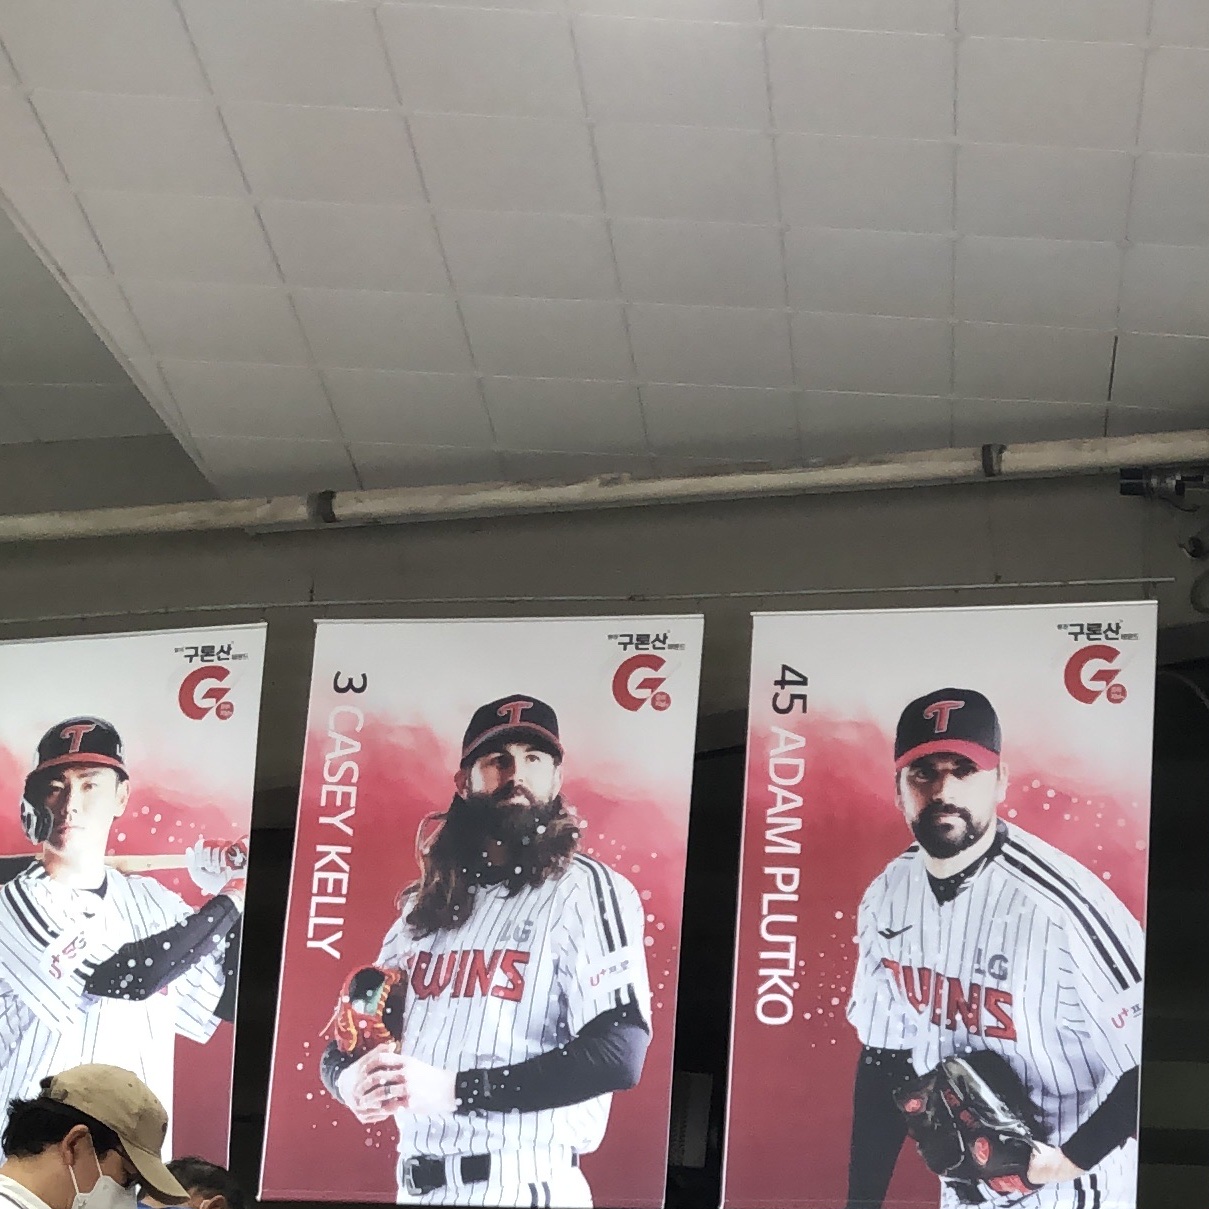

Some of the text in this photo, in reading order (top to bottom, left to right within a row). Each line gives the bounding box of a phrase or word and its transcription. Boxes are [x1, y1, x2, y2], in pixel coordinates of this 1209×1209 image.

[306, 671, 368, 960] 3 CASEY KELLY
[755, 664, 809, 1025] 45 ADAM PLUTKO
[407, 949, 531, 1003] WINS
